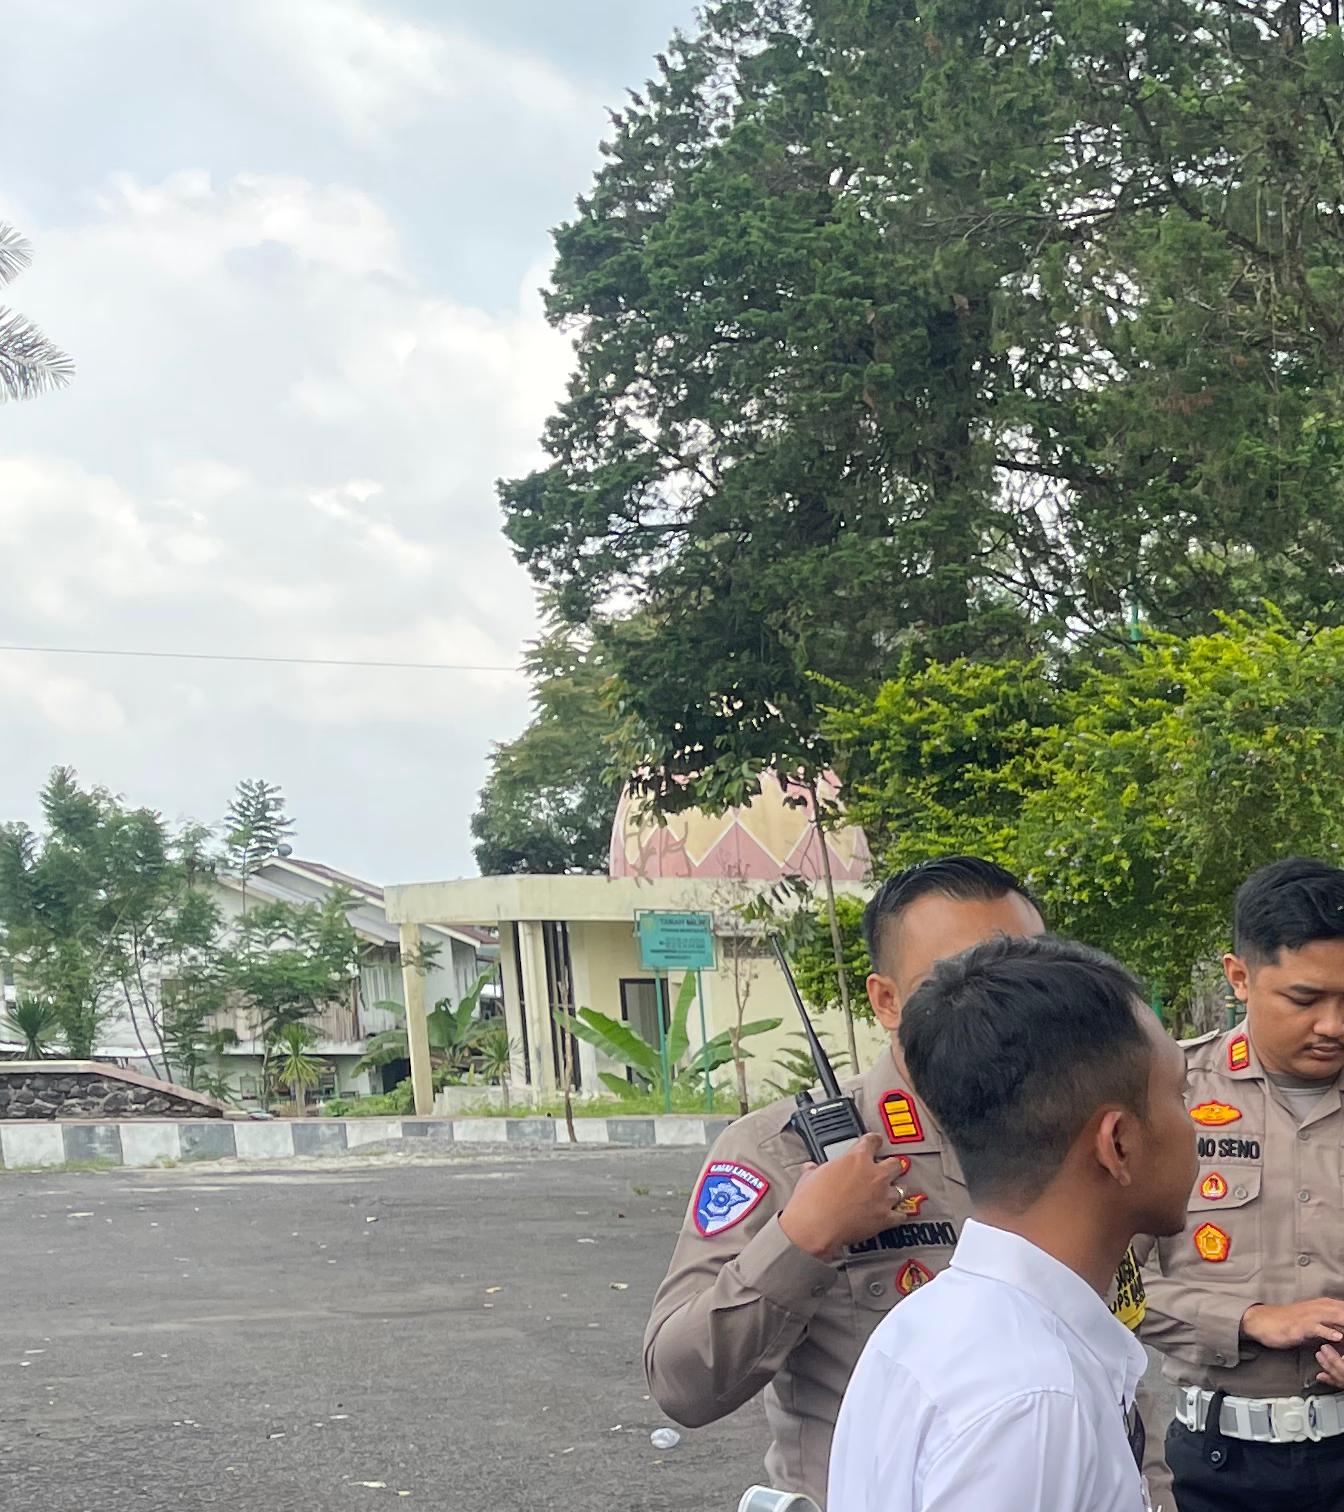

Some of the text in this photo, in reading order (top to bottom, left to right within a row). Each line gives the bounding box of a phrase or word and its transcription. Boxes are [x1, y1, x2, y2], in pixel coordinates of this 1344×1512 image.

[1218, 1138, 1260, 1160] SENO
[732, 1166, 764, 1189] LINTAS
[880, 1222, 957, 1250] NUGROHO
